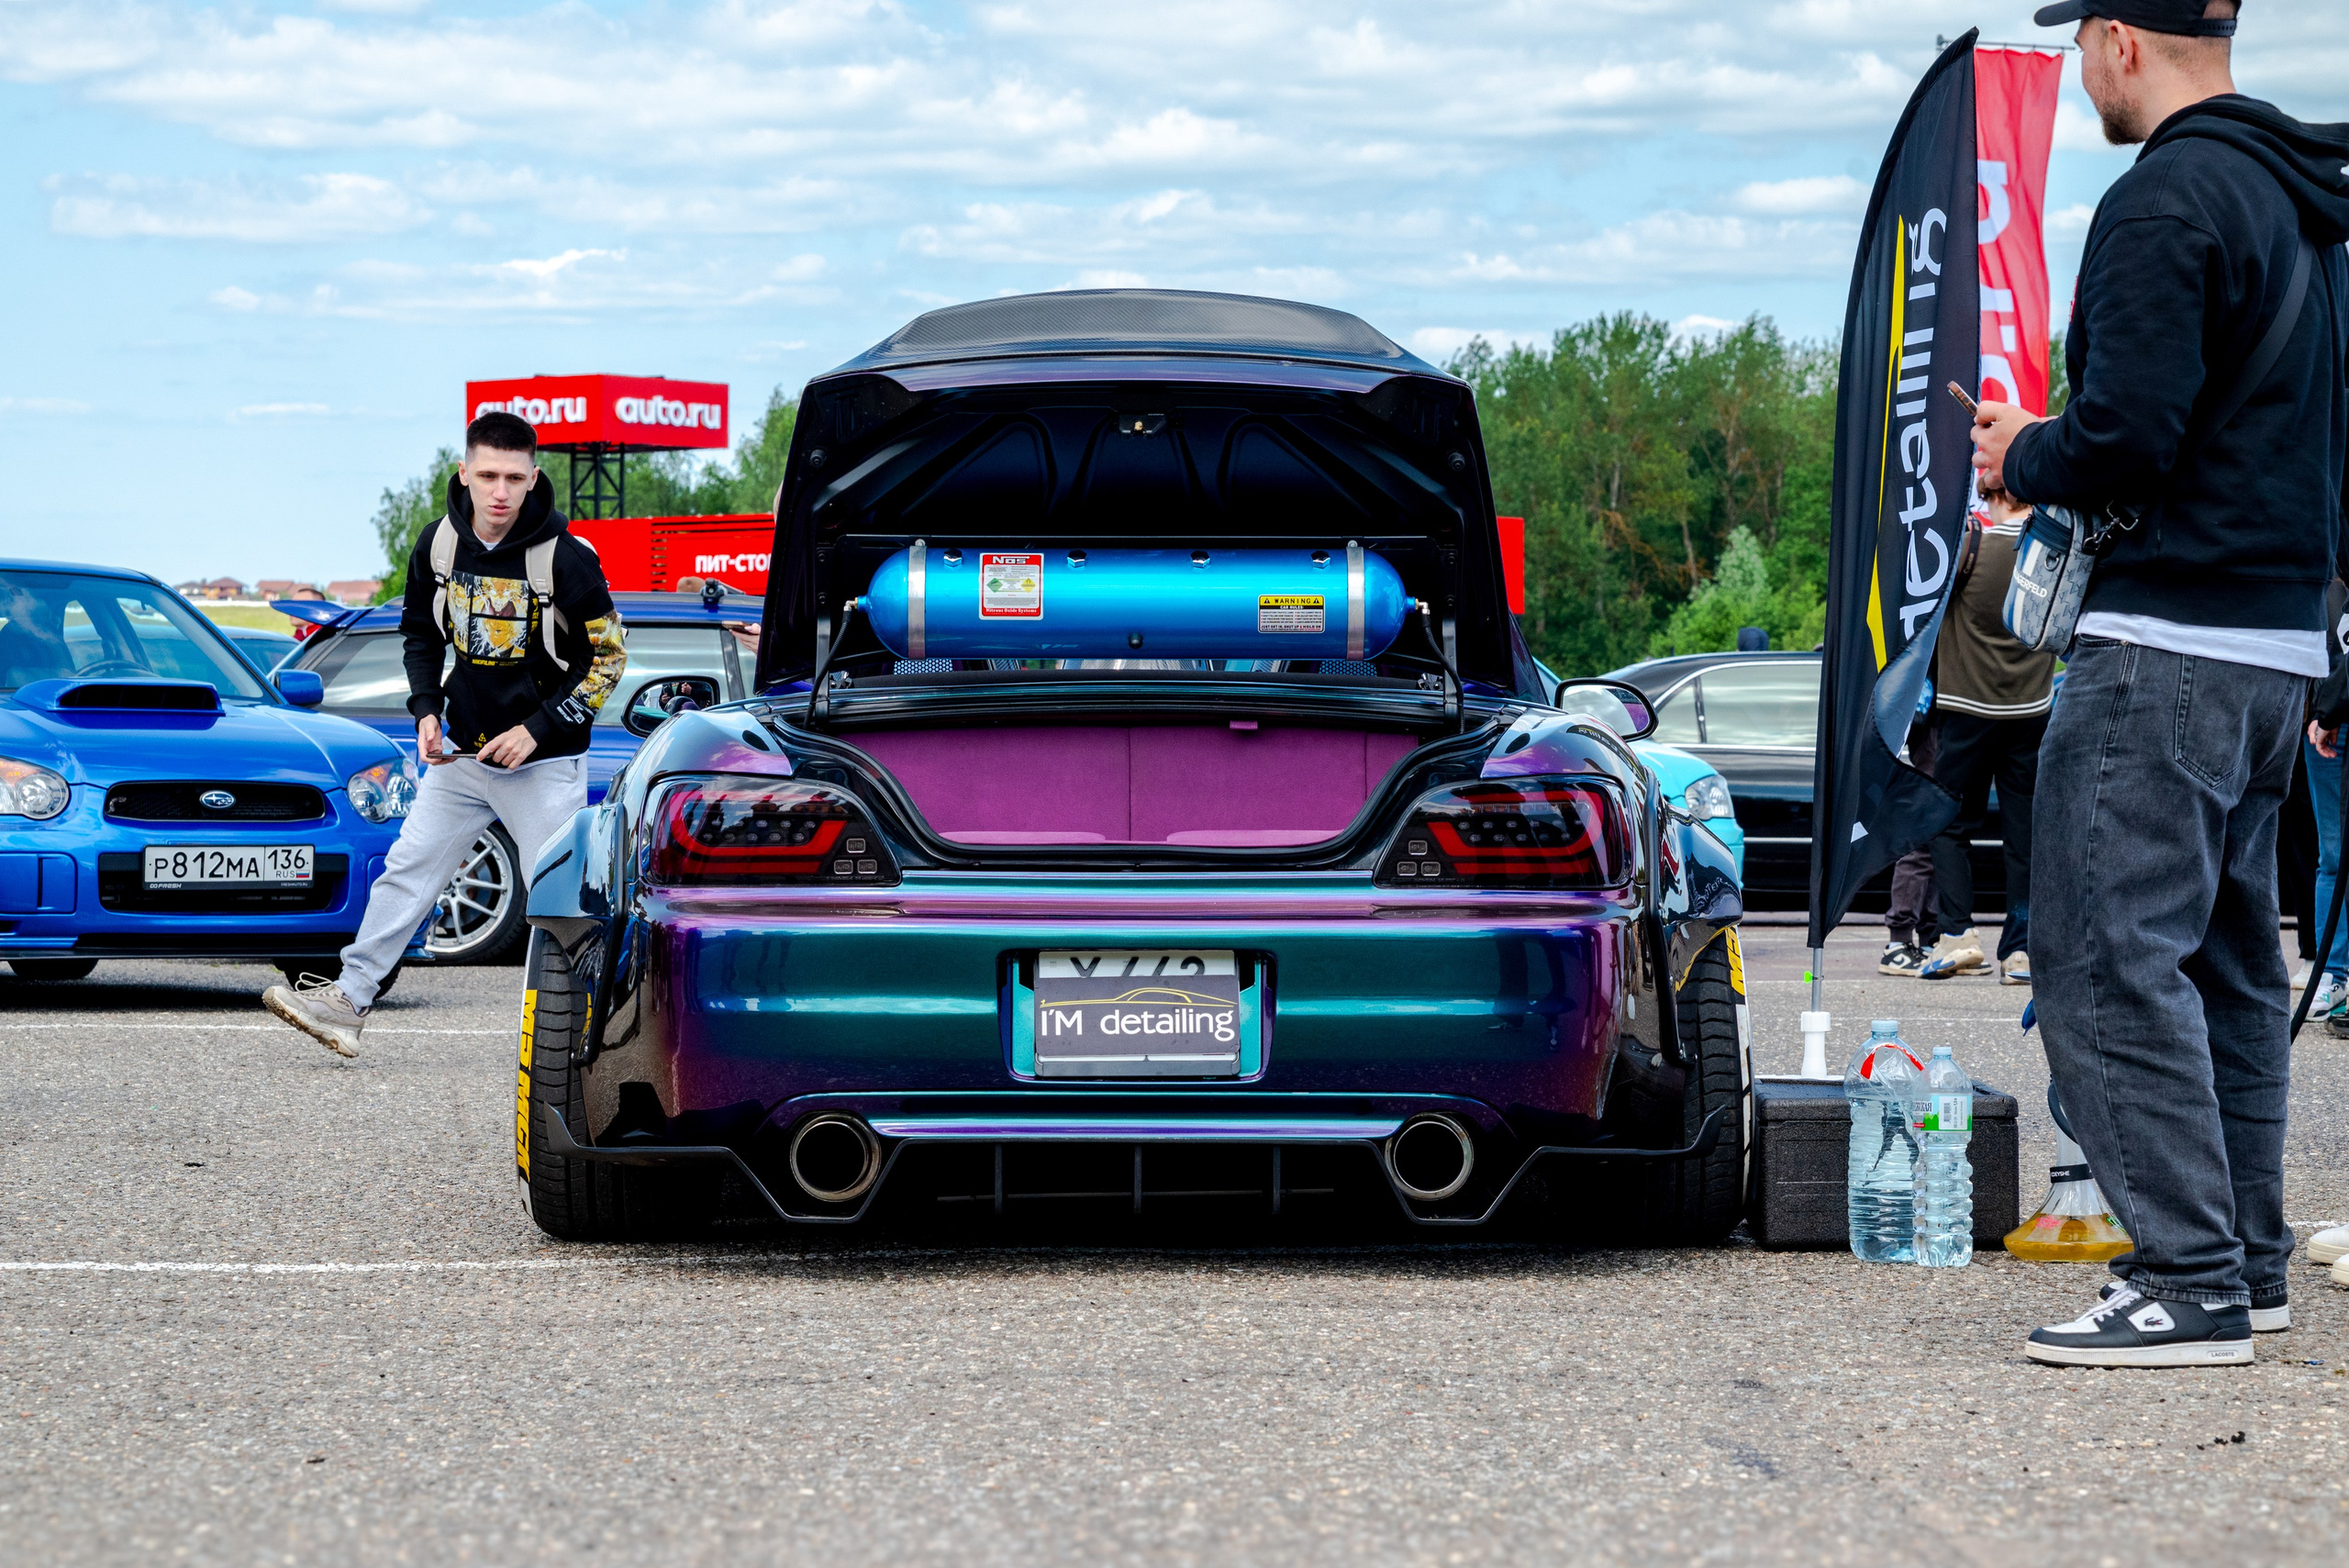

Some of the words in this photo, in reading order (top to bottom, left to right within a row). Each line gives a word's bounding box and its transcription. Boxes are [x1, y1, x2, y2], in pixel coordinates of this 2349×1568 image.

[614, 395, 722, 429] auto.ru
[267, 849, 306, 870] 136
[1041, 1008, 1083, 1037] I'M
[1099, 1007, 1235, 1042] detailing
